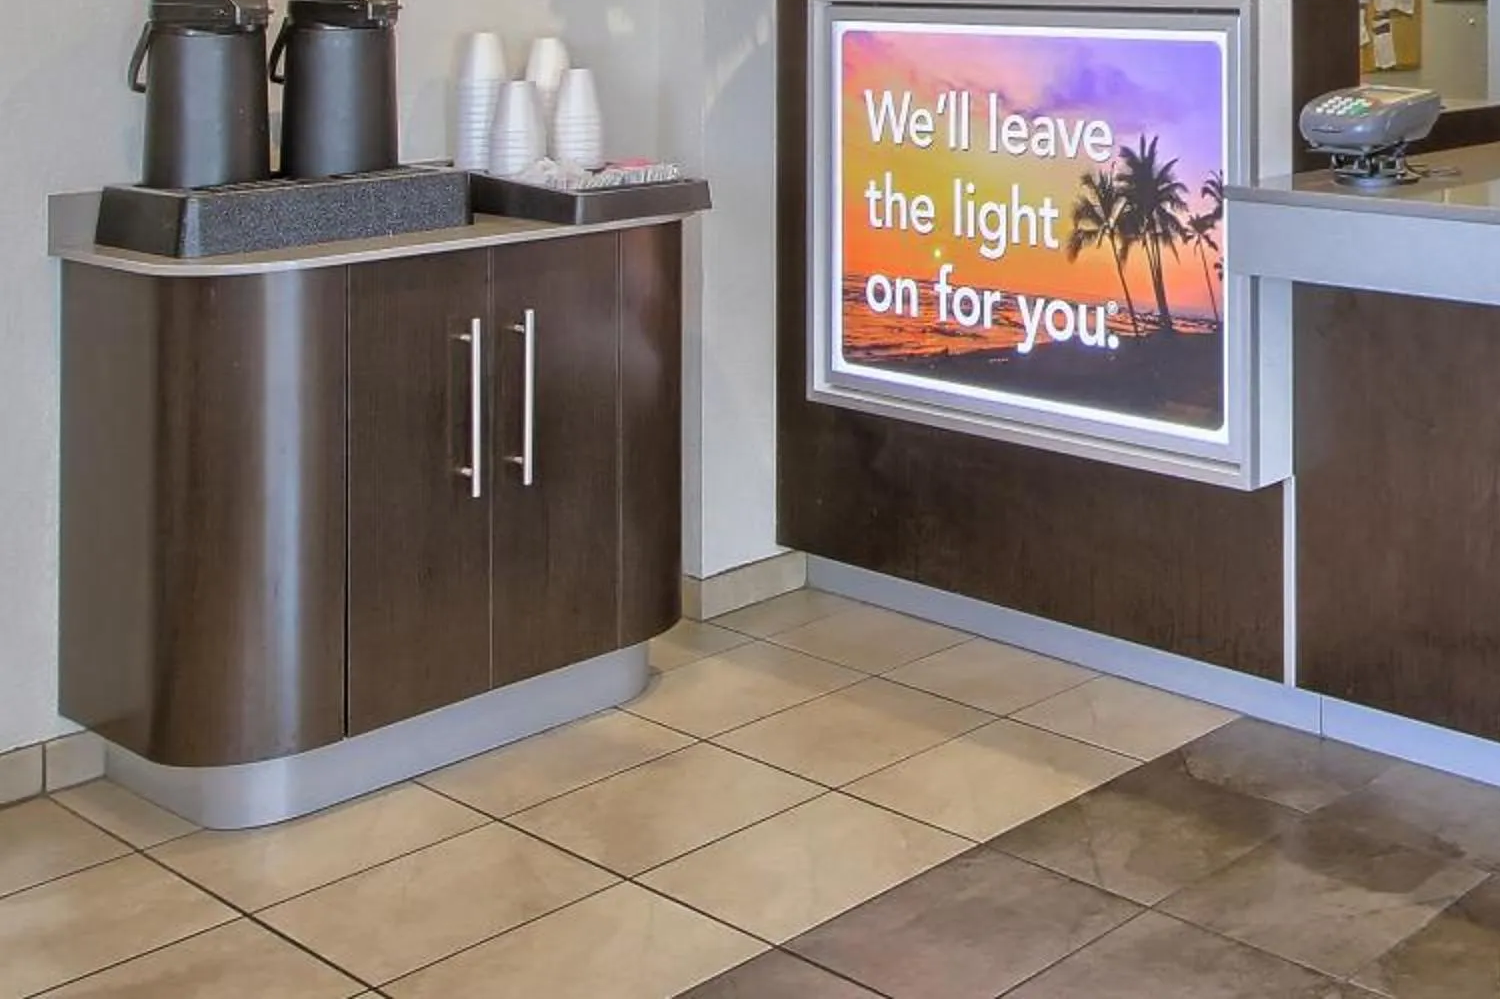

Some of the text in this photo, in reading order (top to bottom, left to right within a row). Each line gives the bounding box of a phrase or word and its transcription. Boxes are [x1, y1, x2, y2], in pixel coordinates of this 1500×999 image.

[863, 88, 1115, 161] We'll leave
[864, 171, 1060, 260] the light
[865, 272, 919, 318] on
[934, 263, 1001, 330] for
